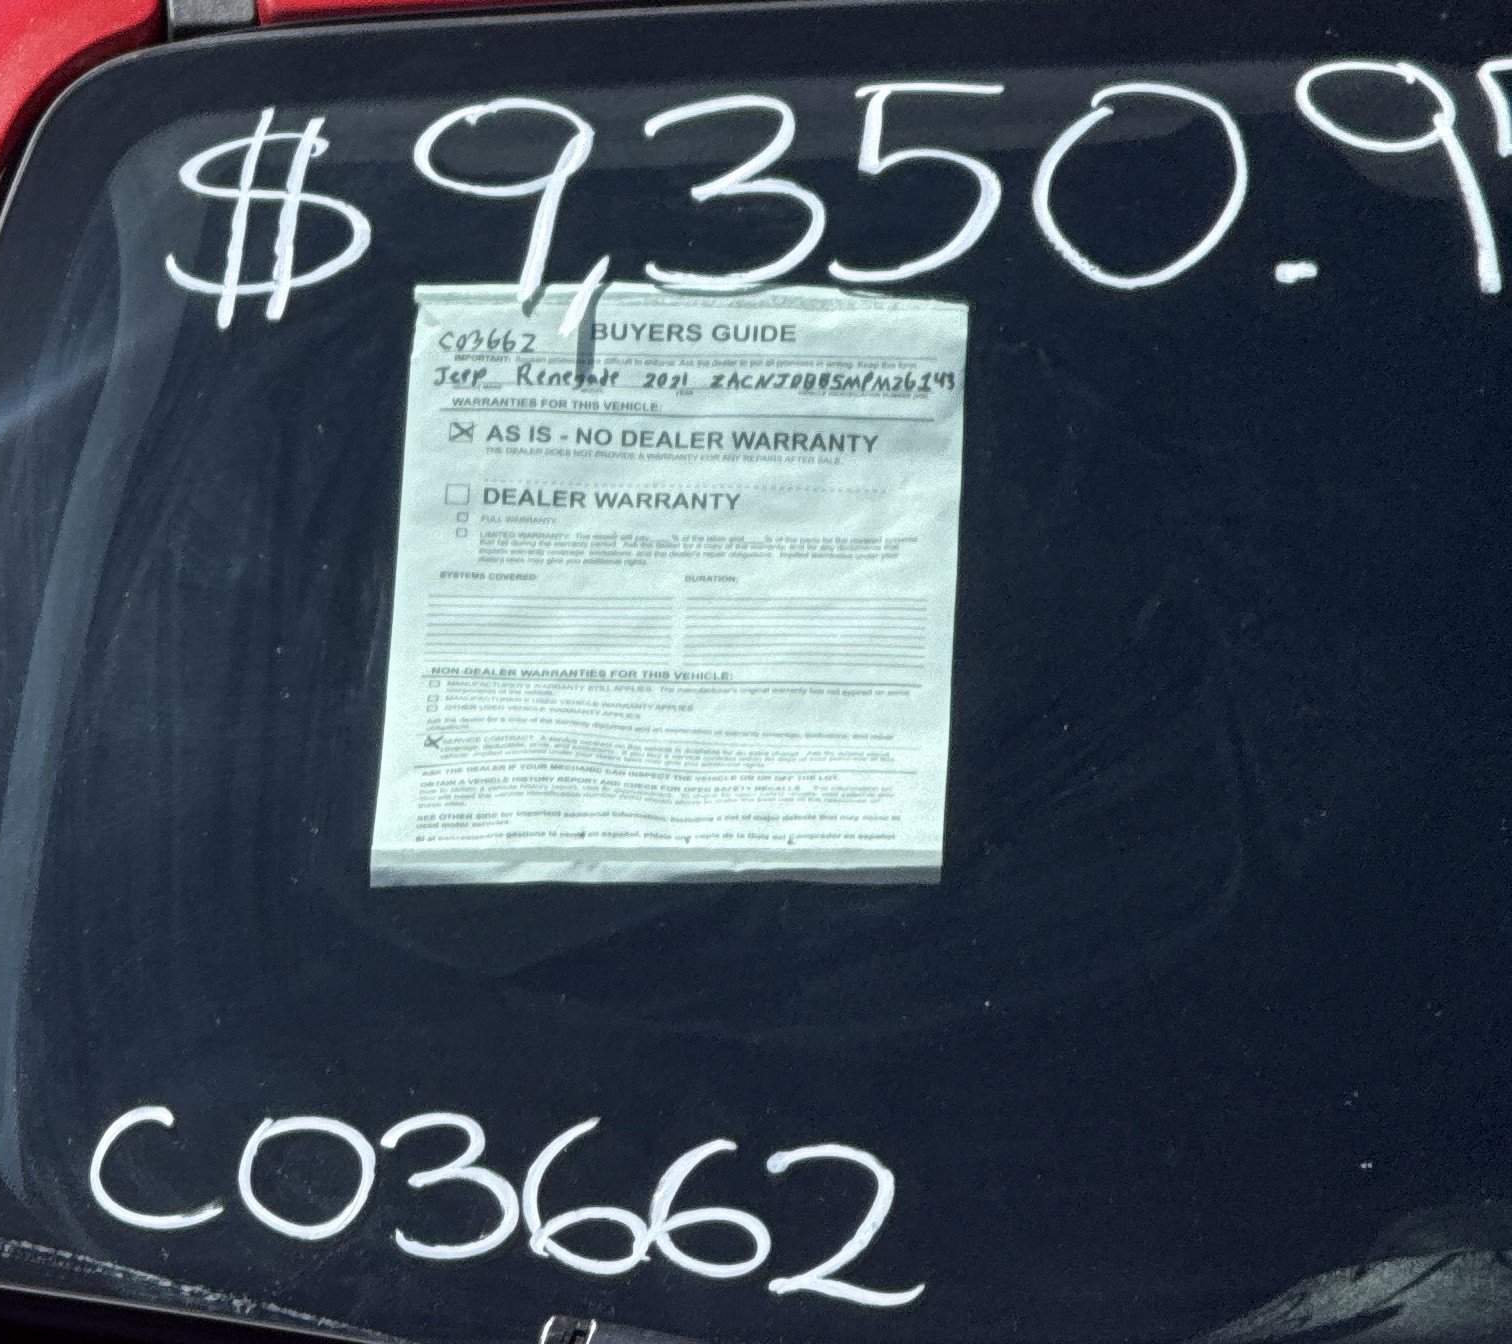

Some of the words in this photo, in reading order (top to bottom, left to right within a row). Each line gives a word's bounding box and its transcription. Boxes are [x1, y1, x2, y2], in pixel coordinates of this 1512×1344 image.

[592, 322, 702, 342] BUYERS
[711, 323, 797, 343] GUIDE
[433, 366, 487, 387] Jeep
[516, 362, 620, 390] Renegade
[642, 371, 688, 389] 2021
[452, 397, 537, 408] WARRANTIES
[540, 399, 568, 409] FOR
[572, 400, 600, 410] THIS
[486, 424, 521, 443] AS
[529, 425, 552, 444] IS
[575, 427, 613, 446] NO
[621, 429, 724, 450] DEALER
[731, 431, 879, 454] WARRANTY
[483, 487, 586, 508] DEALER
[594, 490, 740, 511] WARRANTY
[610, 669, 638, 679] FOR
[641, 670, 670, 680] THIS
